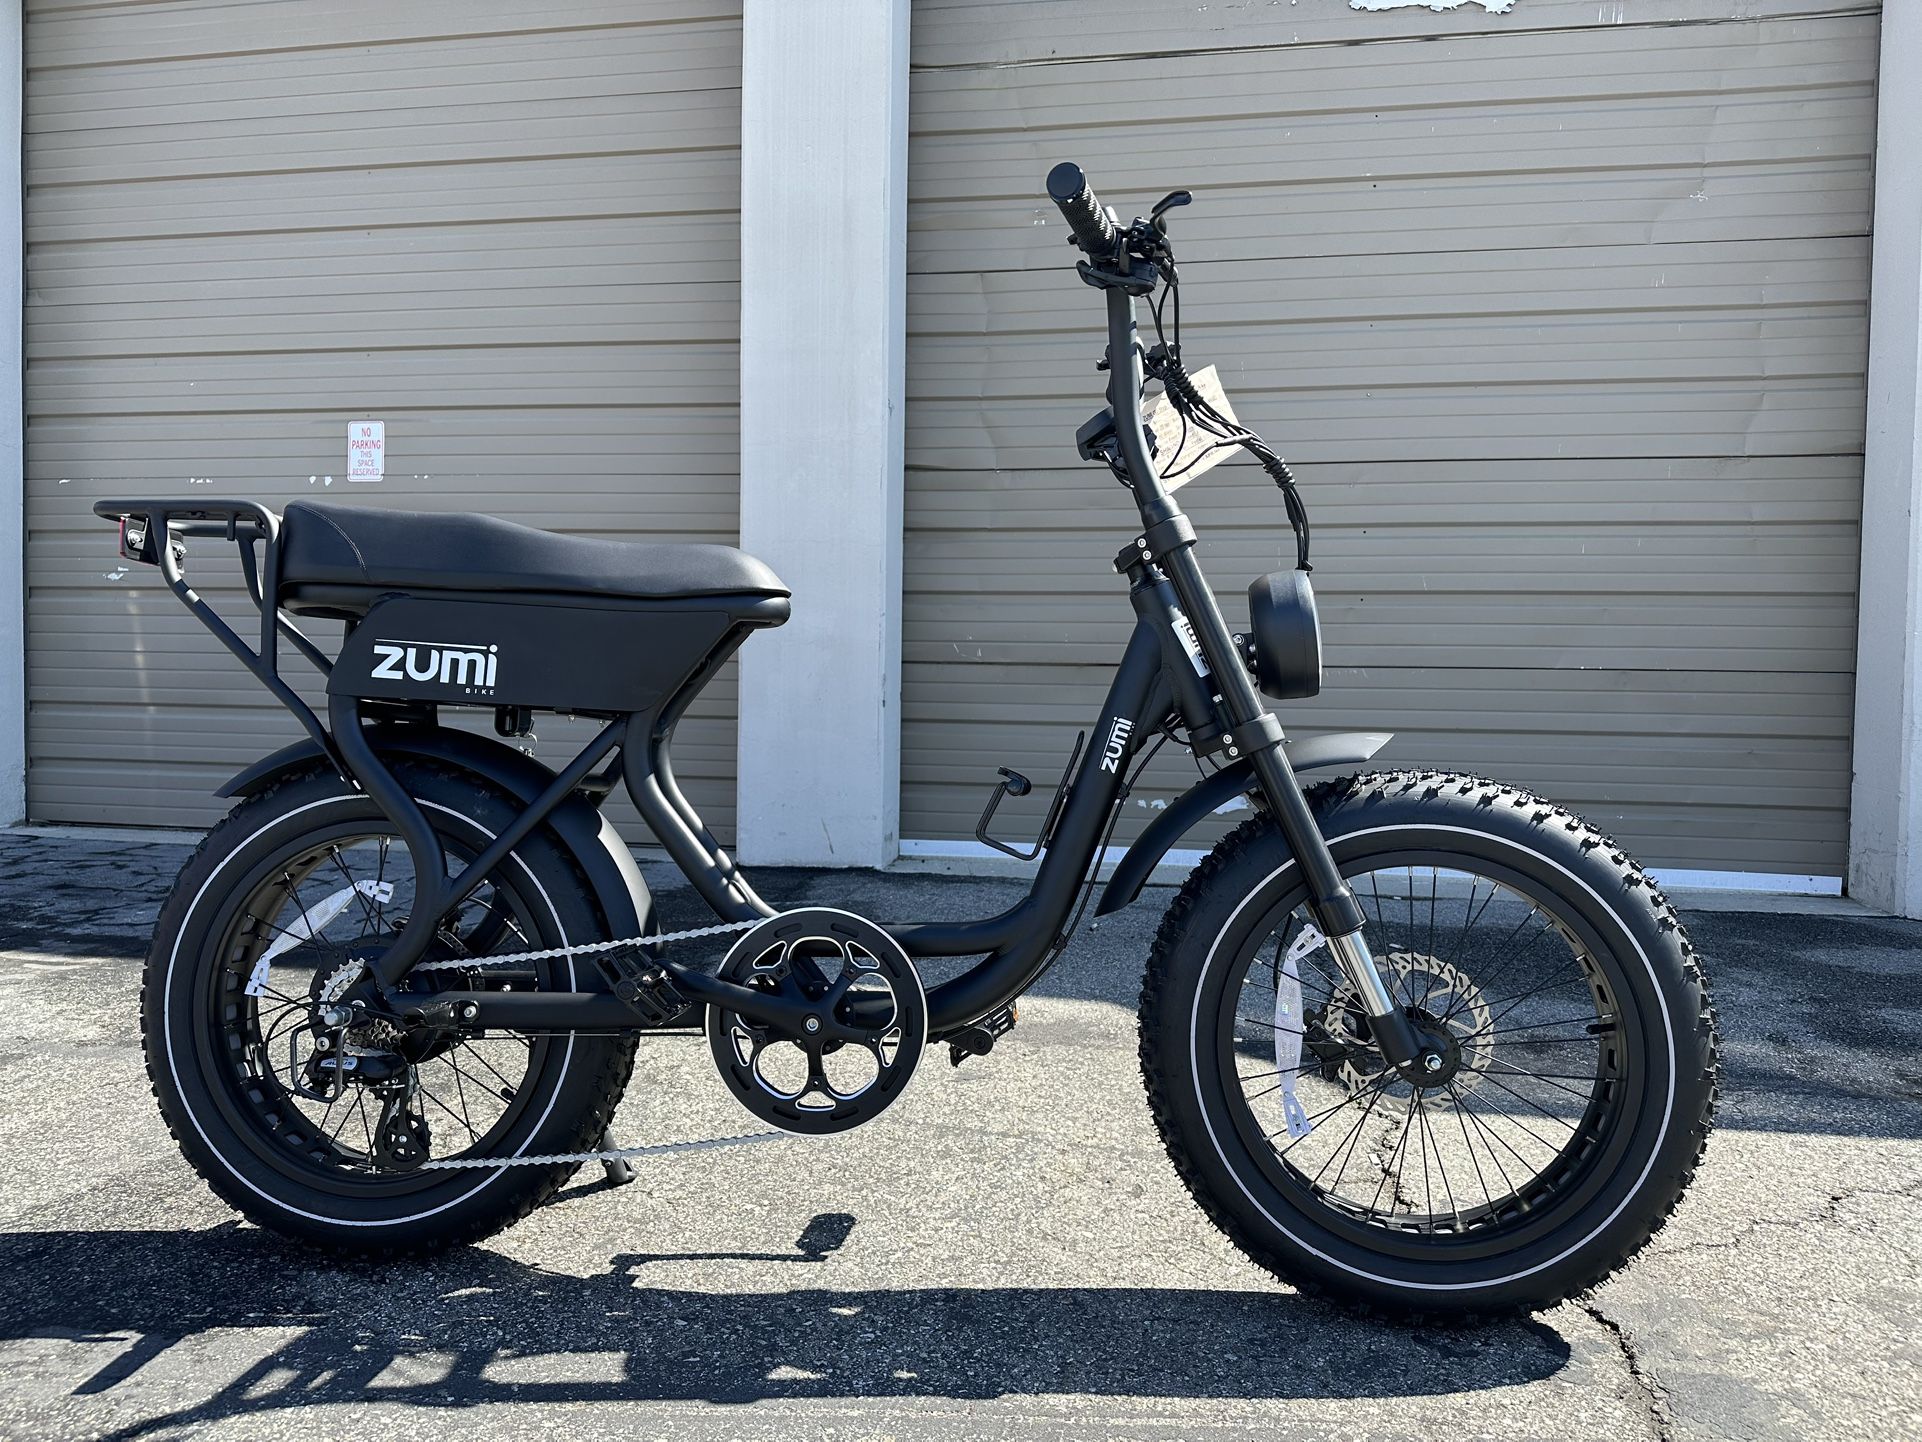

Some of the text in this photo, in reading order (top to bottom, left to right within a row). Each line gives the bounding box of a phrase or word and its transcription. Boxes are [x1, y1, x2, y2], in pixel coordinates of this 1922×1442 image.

[361, 427, 371, 437] NO
[352, 440, 381, 449] PARKING
[360, 450, 372, 458] THIS
[357, 459, 375, 467] SPACE
[352, 468, 380, 476] RESERVED
[371, 643, 498, 687] zumi
[465, 687, 495, 696] BIKE
